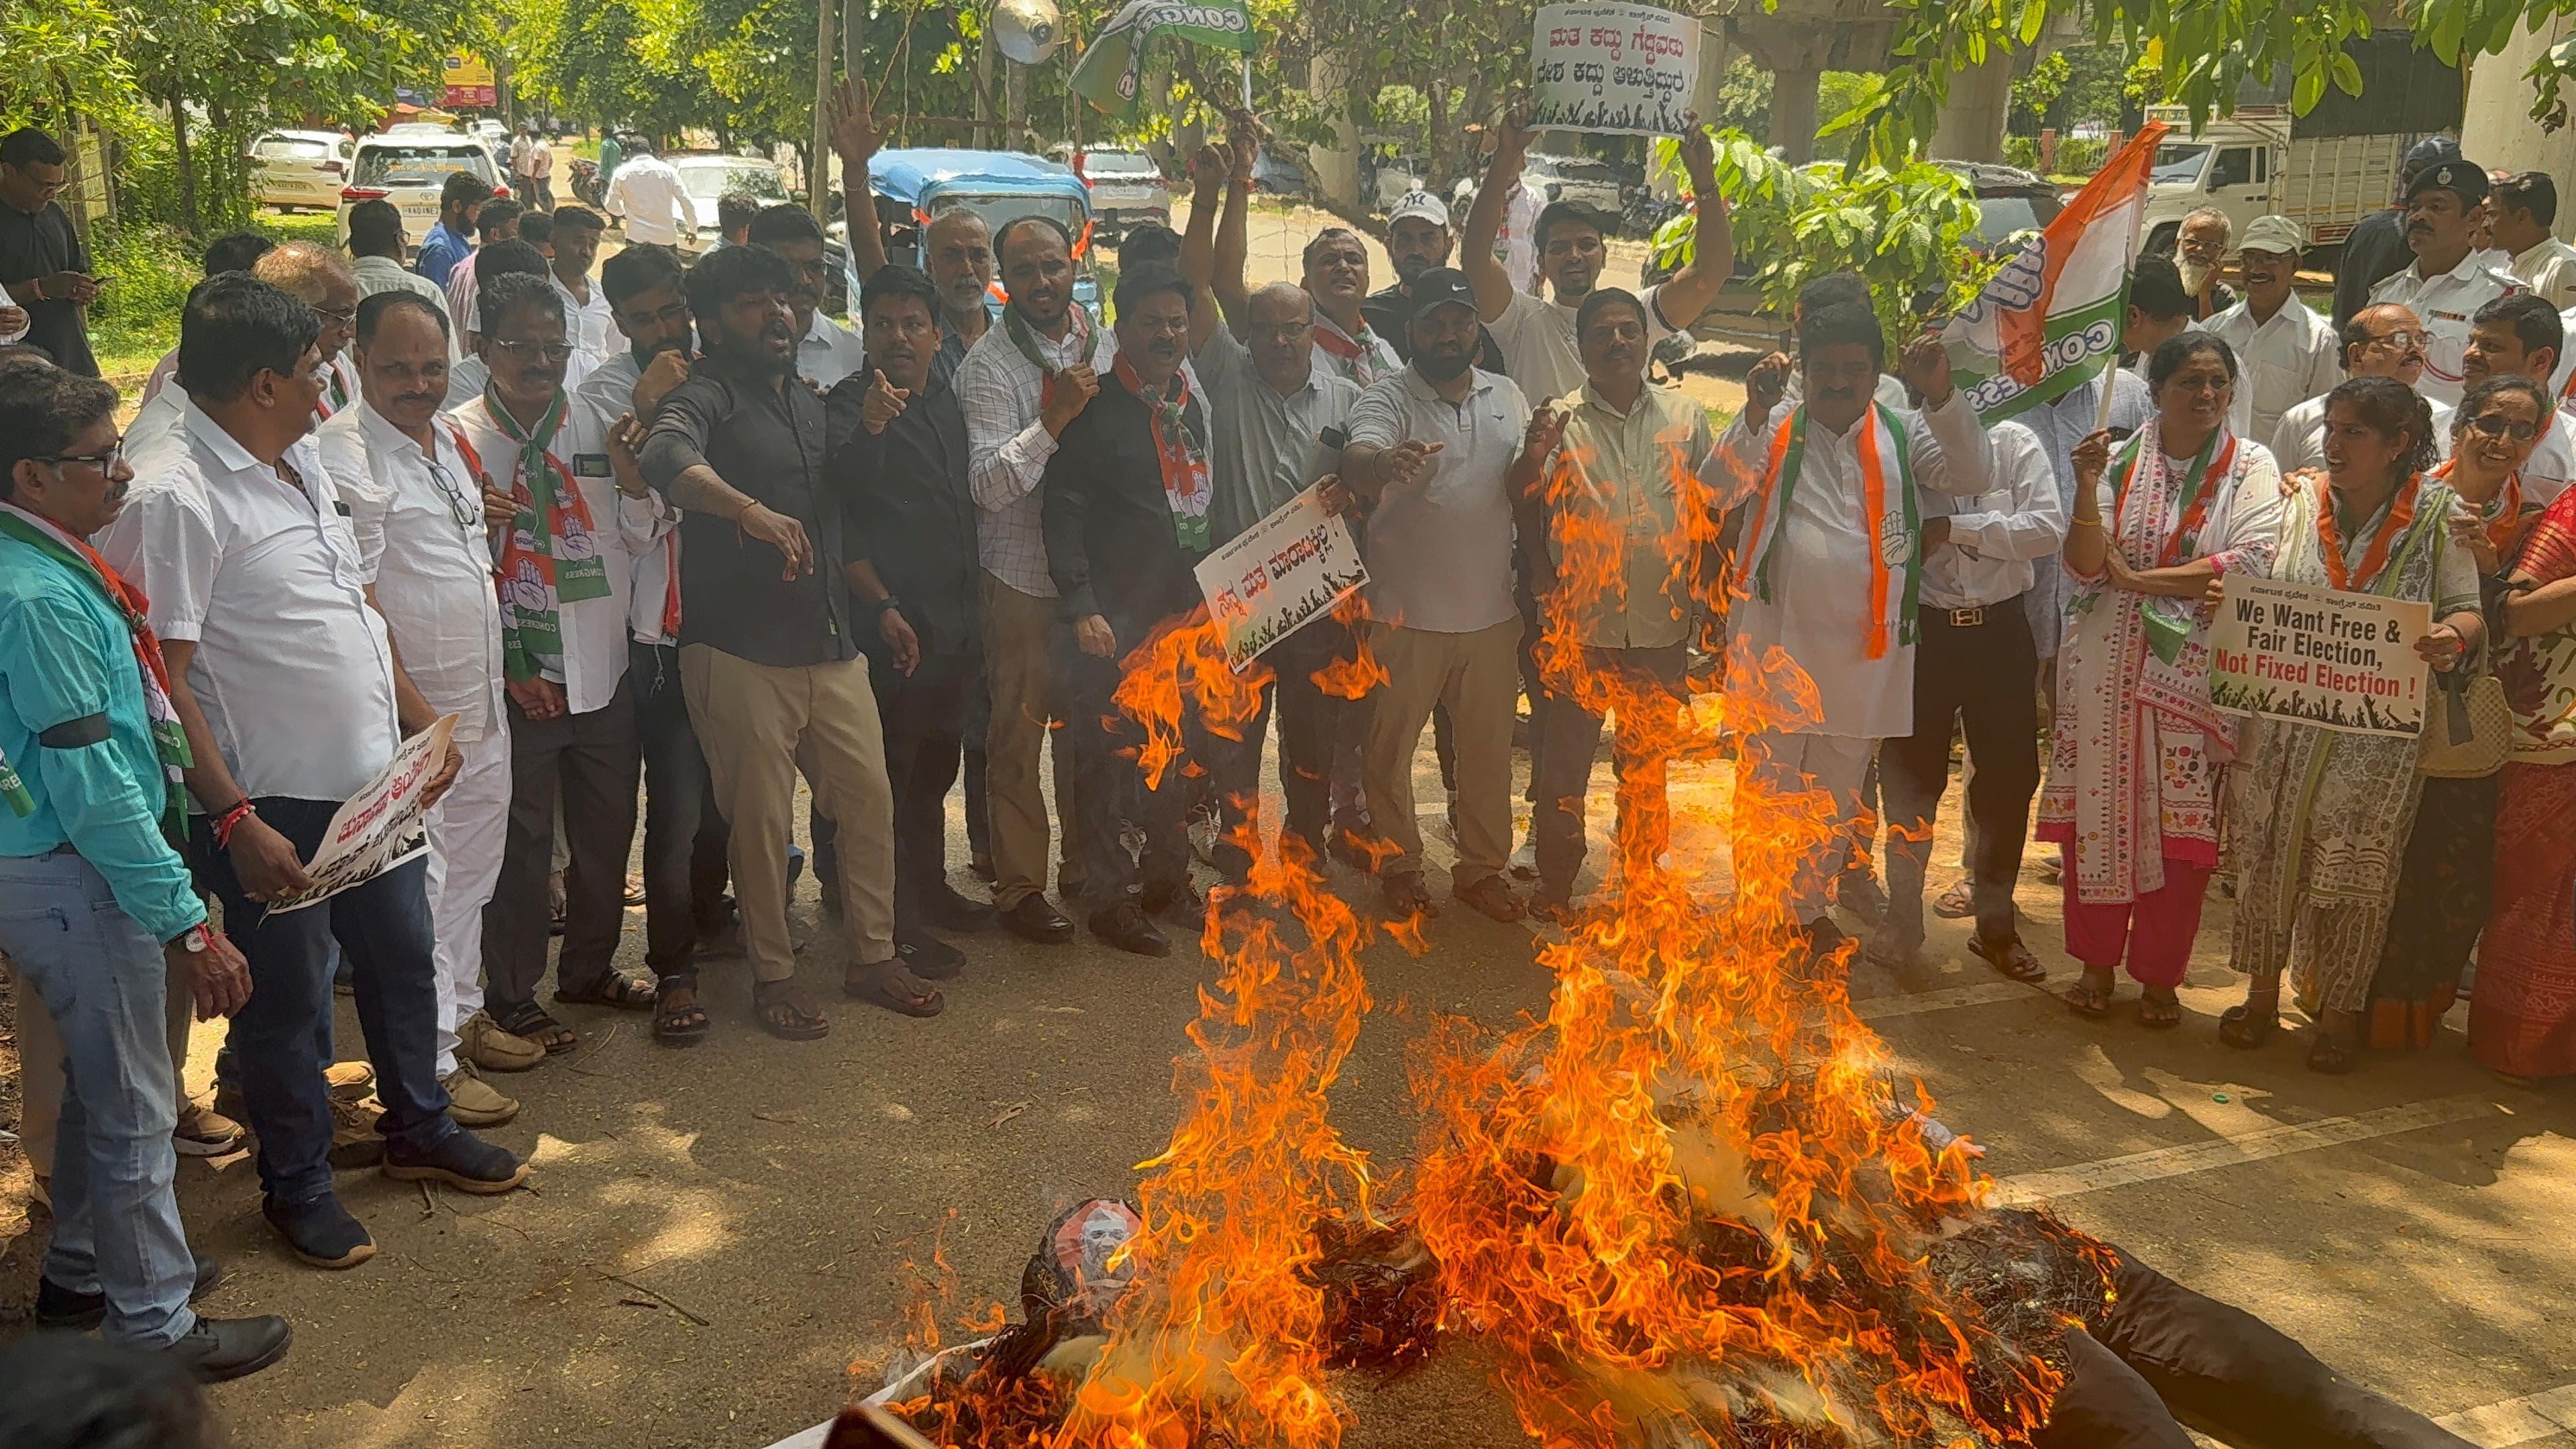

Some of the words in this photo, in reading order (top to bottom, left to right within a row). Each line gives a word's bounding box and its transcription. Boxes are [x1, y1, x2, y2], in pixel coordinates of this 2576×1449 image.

[1550, 26, 1581, 47] ಮತ
[1590, 27, 1621, 62] ಕದ್ದು
[1631, 24, 1684, 65] ಗೆದ್ದವರು
[1538, 58, 1565, 84] ದೇಶ
[1574, 62, 1604, 96] ಕದ್ದು
[1241, 559, 1267, 598] ಮತ
[2236, 598, 2264, 624] We
[2273, 603, 2323, 633] Want
[2330, 613, 2375, 641] Free
[2385, 620, 2400, 643] &
[2248, 627, 2286, 652] Fair
[2294, 633, 2382, 671] Election,
[2216, 648, 2248, 675] Not
[2255, 654, 2308, 684] Fixed
[2316, 664, 2400, 698] Election
[2409, 678, 2415, 700] !
